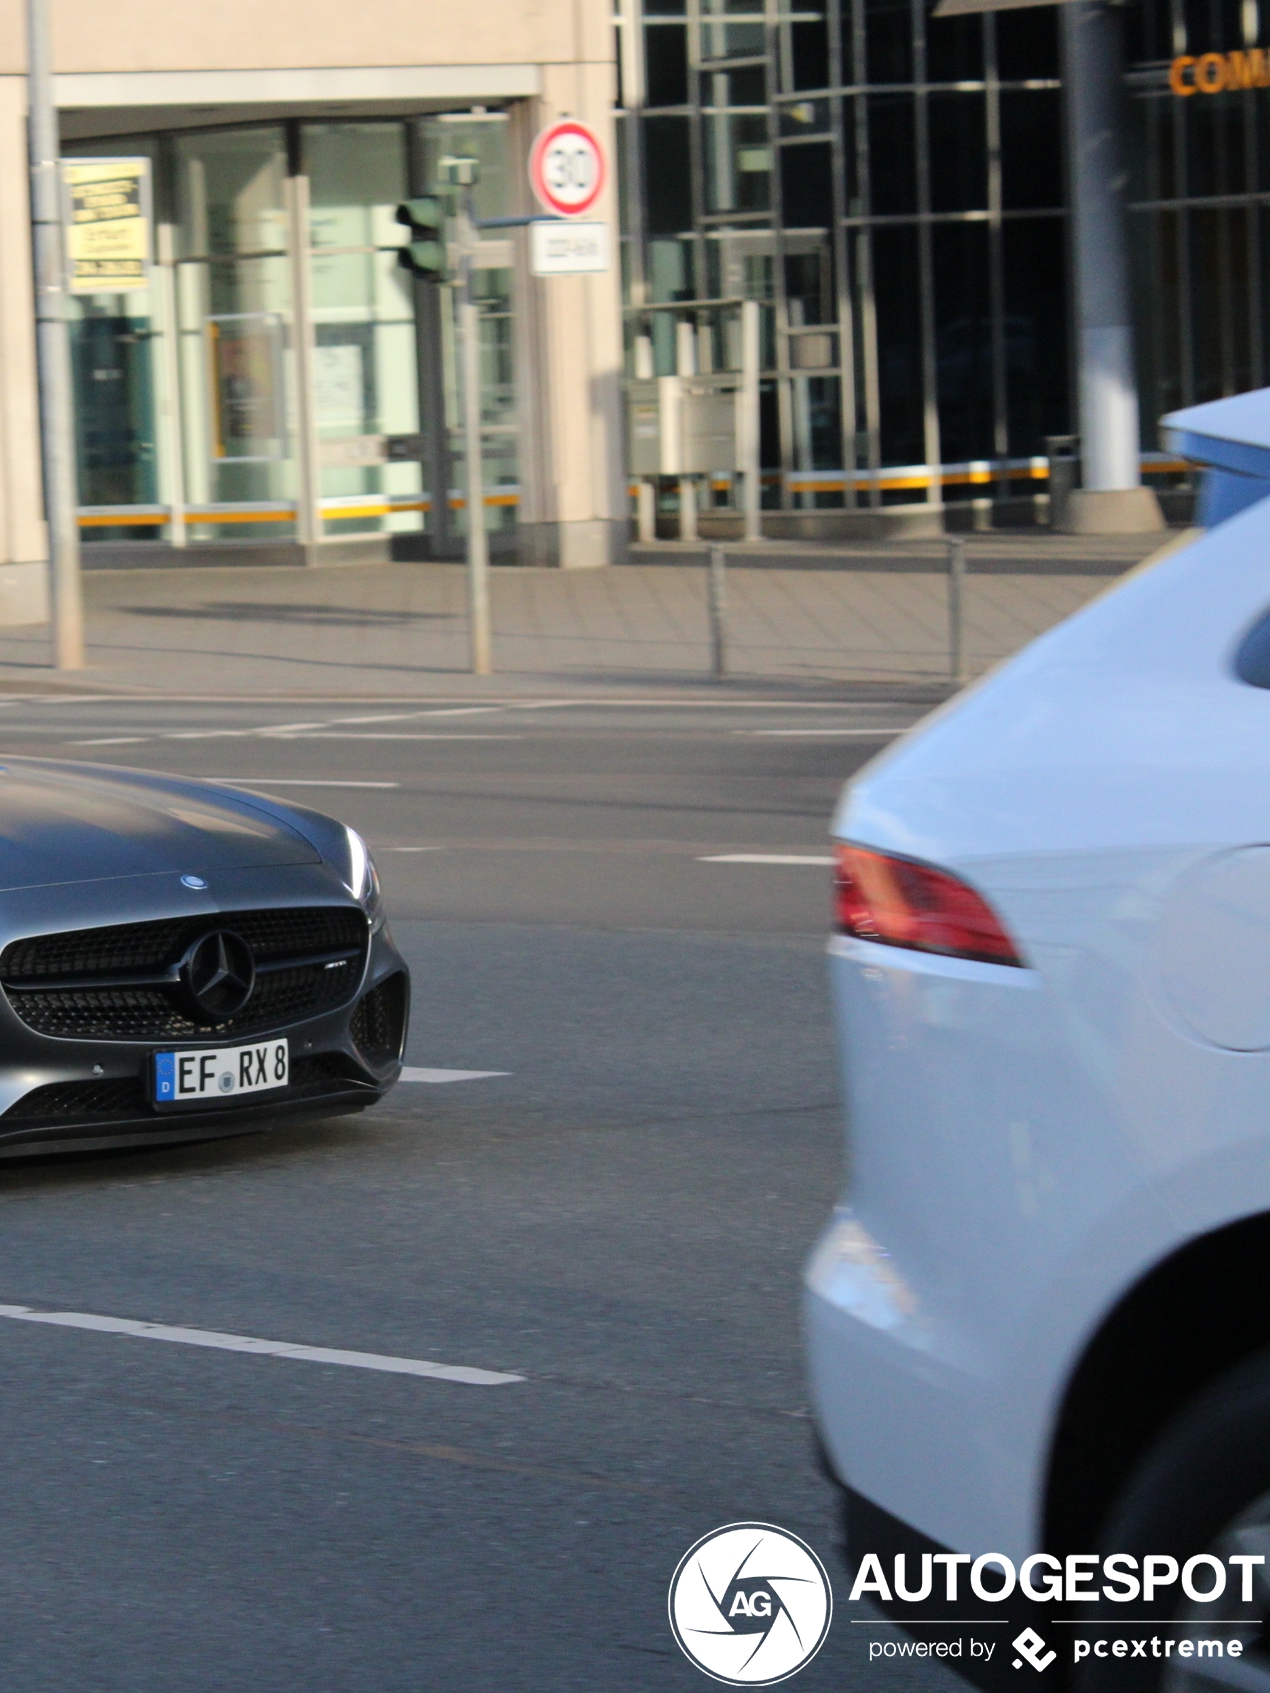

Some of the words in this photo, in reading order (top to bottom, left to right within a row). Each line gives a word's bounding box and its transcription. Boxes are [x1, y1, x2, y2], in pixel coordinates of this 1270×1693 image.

[1169, 47, 1270, 96] COM
[547, 149, 593, 189] 30
[161, 1081, 171, 1093] D
[178, 1054, 217, 1093] EF
[239, 1047, 267, 1087] RX
[274, 1045, 286, 1081] 8
